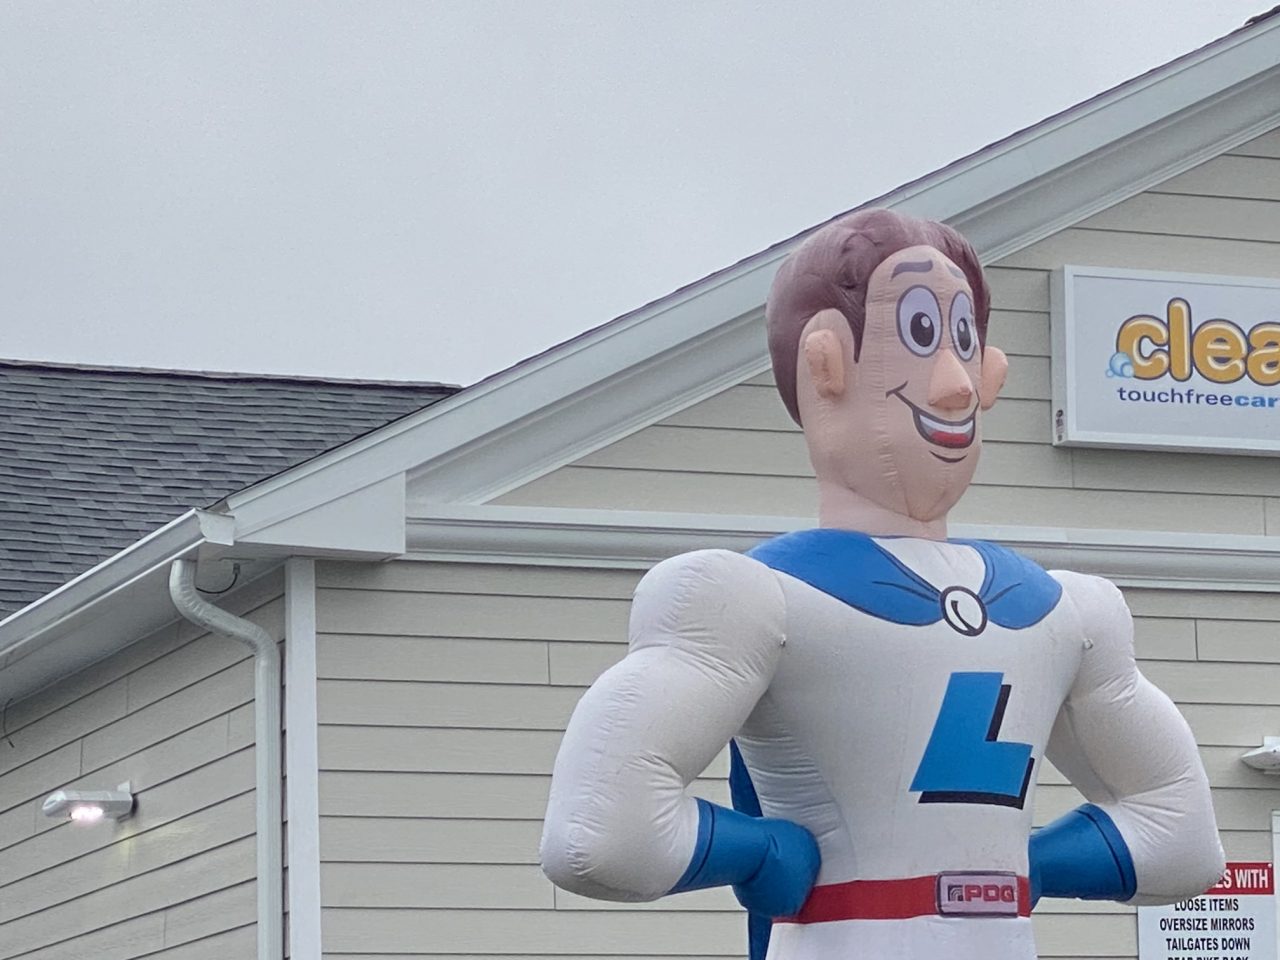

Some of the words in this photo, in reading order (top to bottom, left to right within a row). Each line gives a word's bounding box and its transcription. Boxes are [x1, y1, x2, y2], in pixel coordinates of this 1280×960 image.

[909, 672, 1035, 809] L
[1234, 868, 1268, 888] WITH
[1174, 898, 1207, 911] LOOSE
[1209, 898, 1239, 911] ITEMS
[1160, 918, 1208, 931] OVERSIZE
[1210, 917, 1255, 931] MIRRORS
[1166, 938, 1219, 951] TAILGATES
[1221, 937, 1250, 950] DOWN
